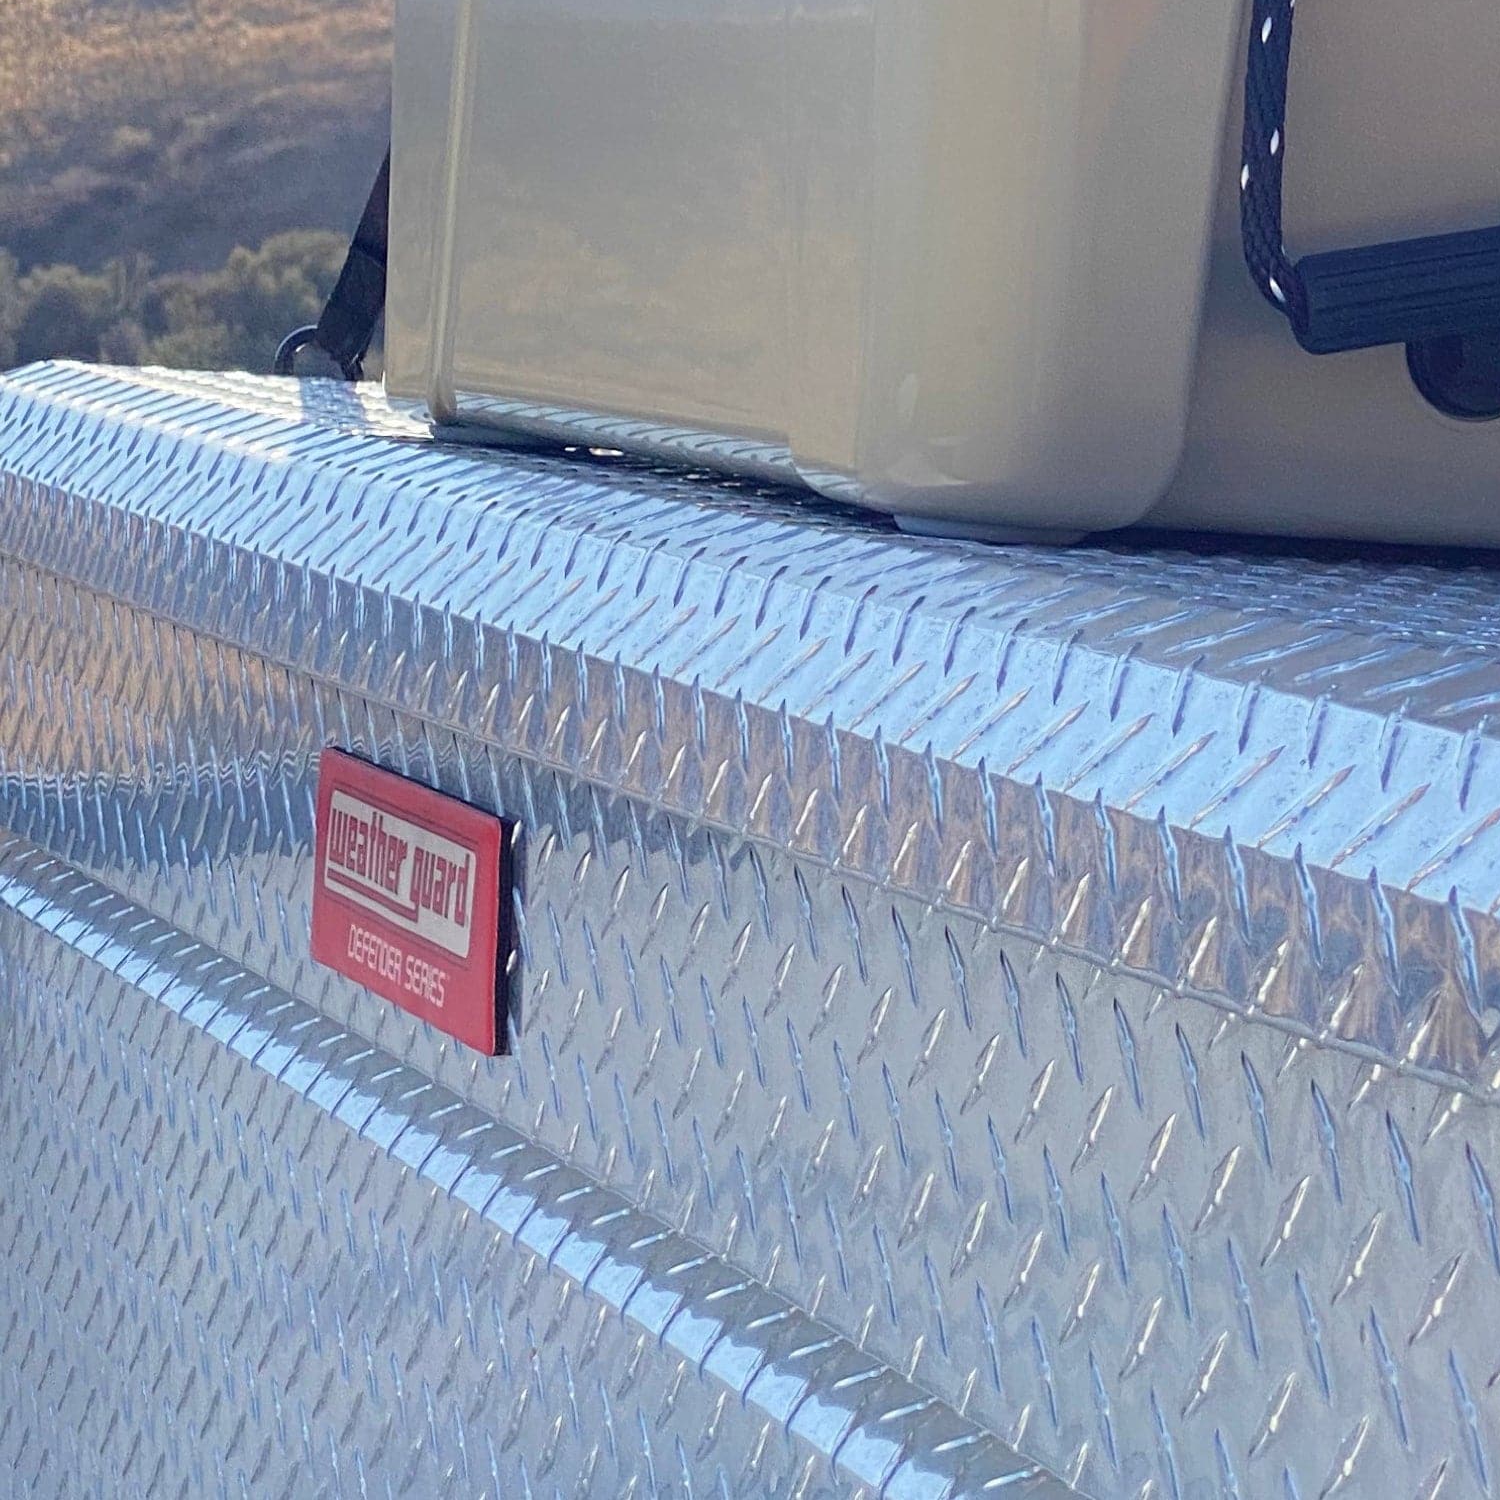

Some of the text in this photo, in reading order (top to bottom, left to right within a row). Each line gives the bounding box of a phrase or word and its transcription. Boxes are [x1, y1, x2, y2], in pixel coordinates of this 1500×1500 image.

[328, 807, 470, 928] weather guard
[347, 924, 446, 1008] DEFENDER SERIES
